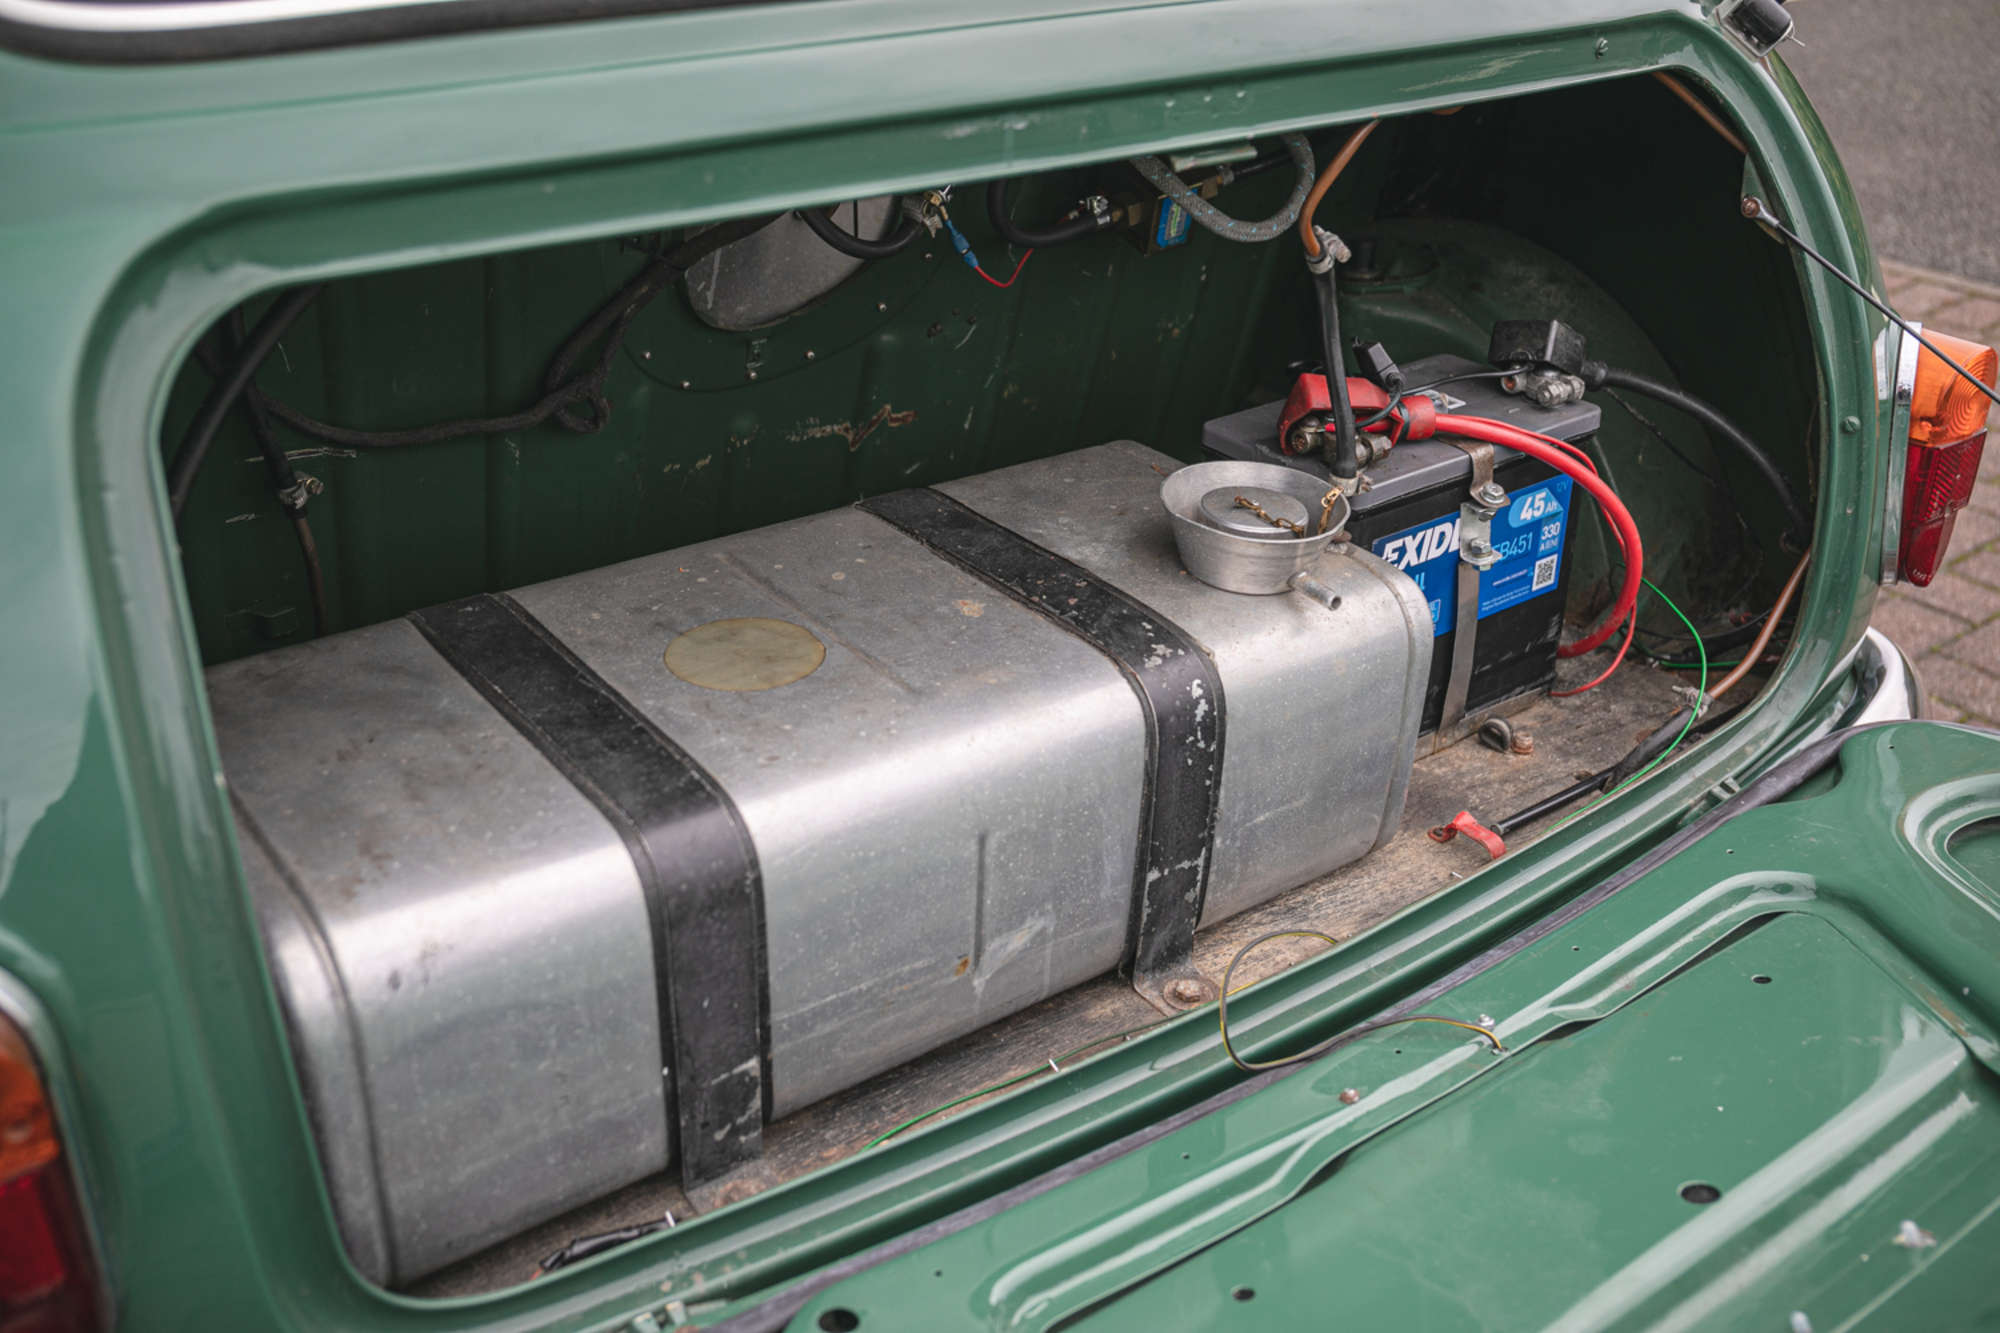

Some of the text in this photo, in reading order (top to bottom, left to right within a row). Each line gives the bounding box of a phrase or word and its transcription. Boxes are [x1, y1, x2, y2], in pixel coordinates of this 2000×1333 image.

[1520, 491, 1547, 521] 45
[1541, 521, 1561, 540] 330
[1492, 531, 1533, 561] B451
